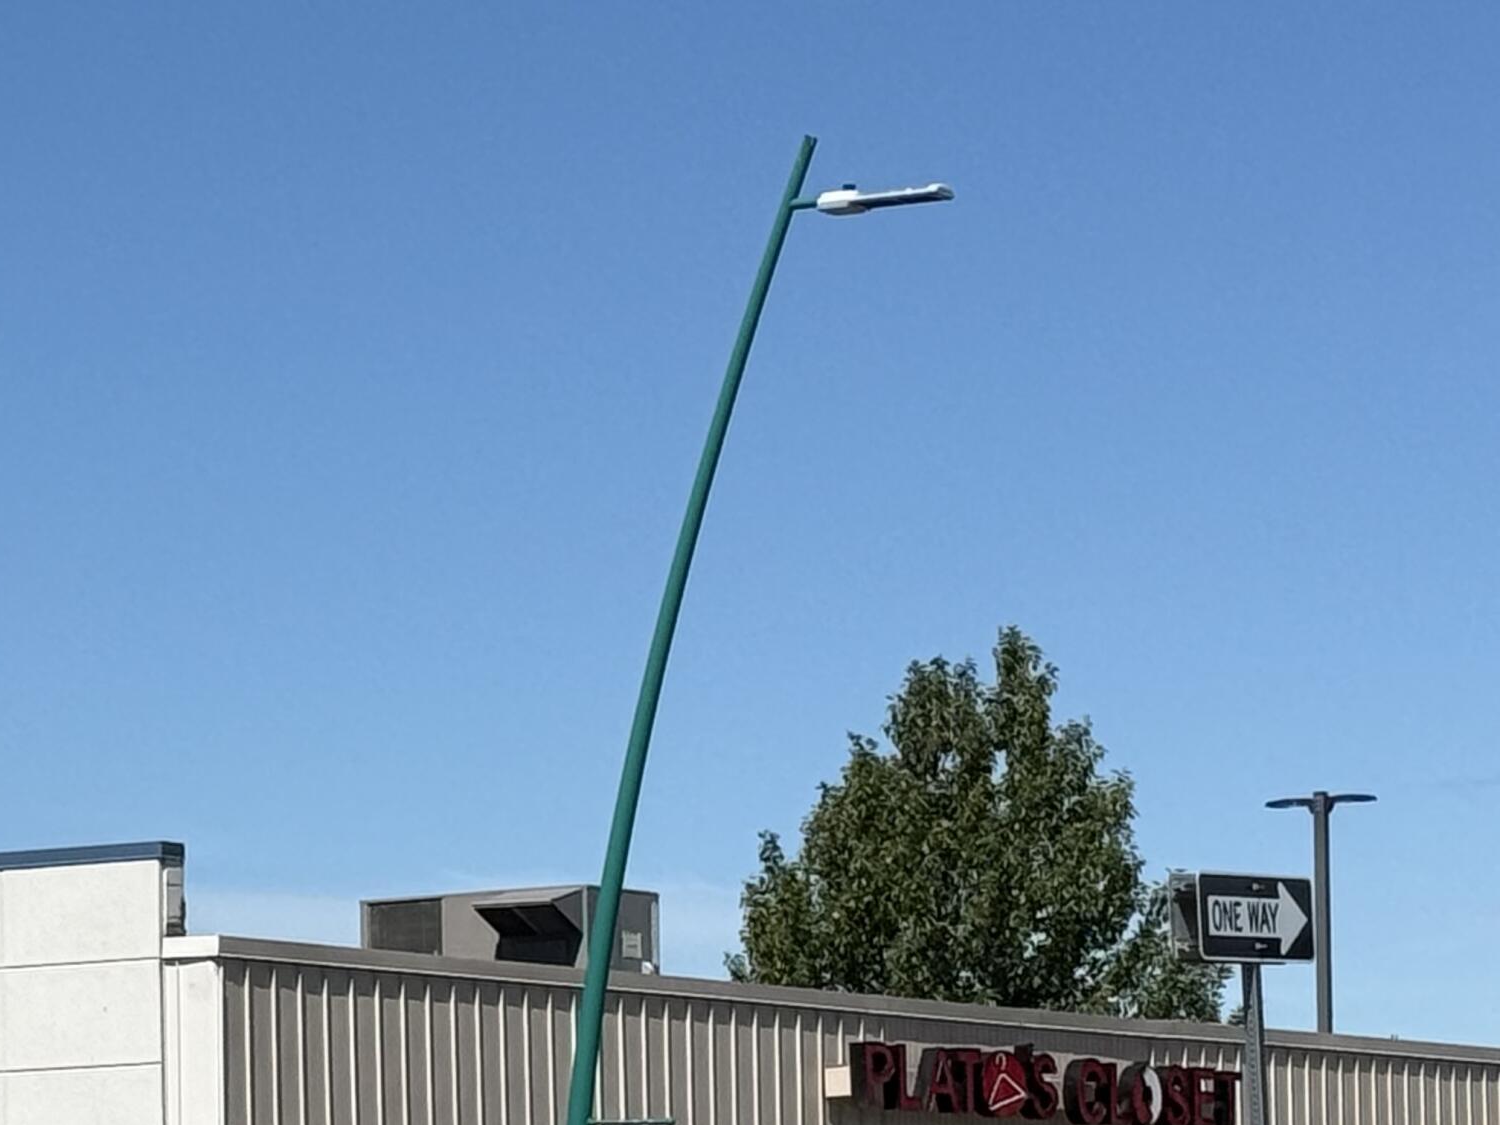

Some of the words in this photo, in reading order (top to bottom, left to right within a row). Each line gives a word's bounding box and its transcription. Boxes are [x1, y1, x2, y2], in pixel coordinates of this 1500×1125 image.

[1211, 899, 1243, 933] ONE
[1247, 901, 1280, 934] WAY
[852, 1042, 1059, 1120] PLATO'S
